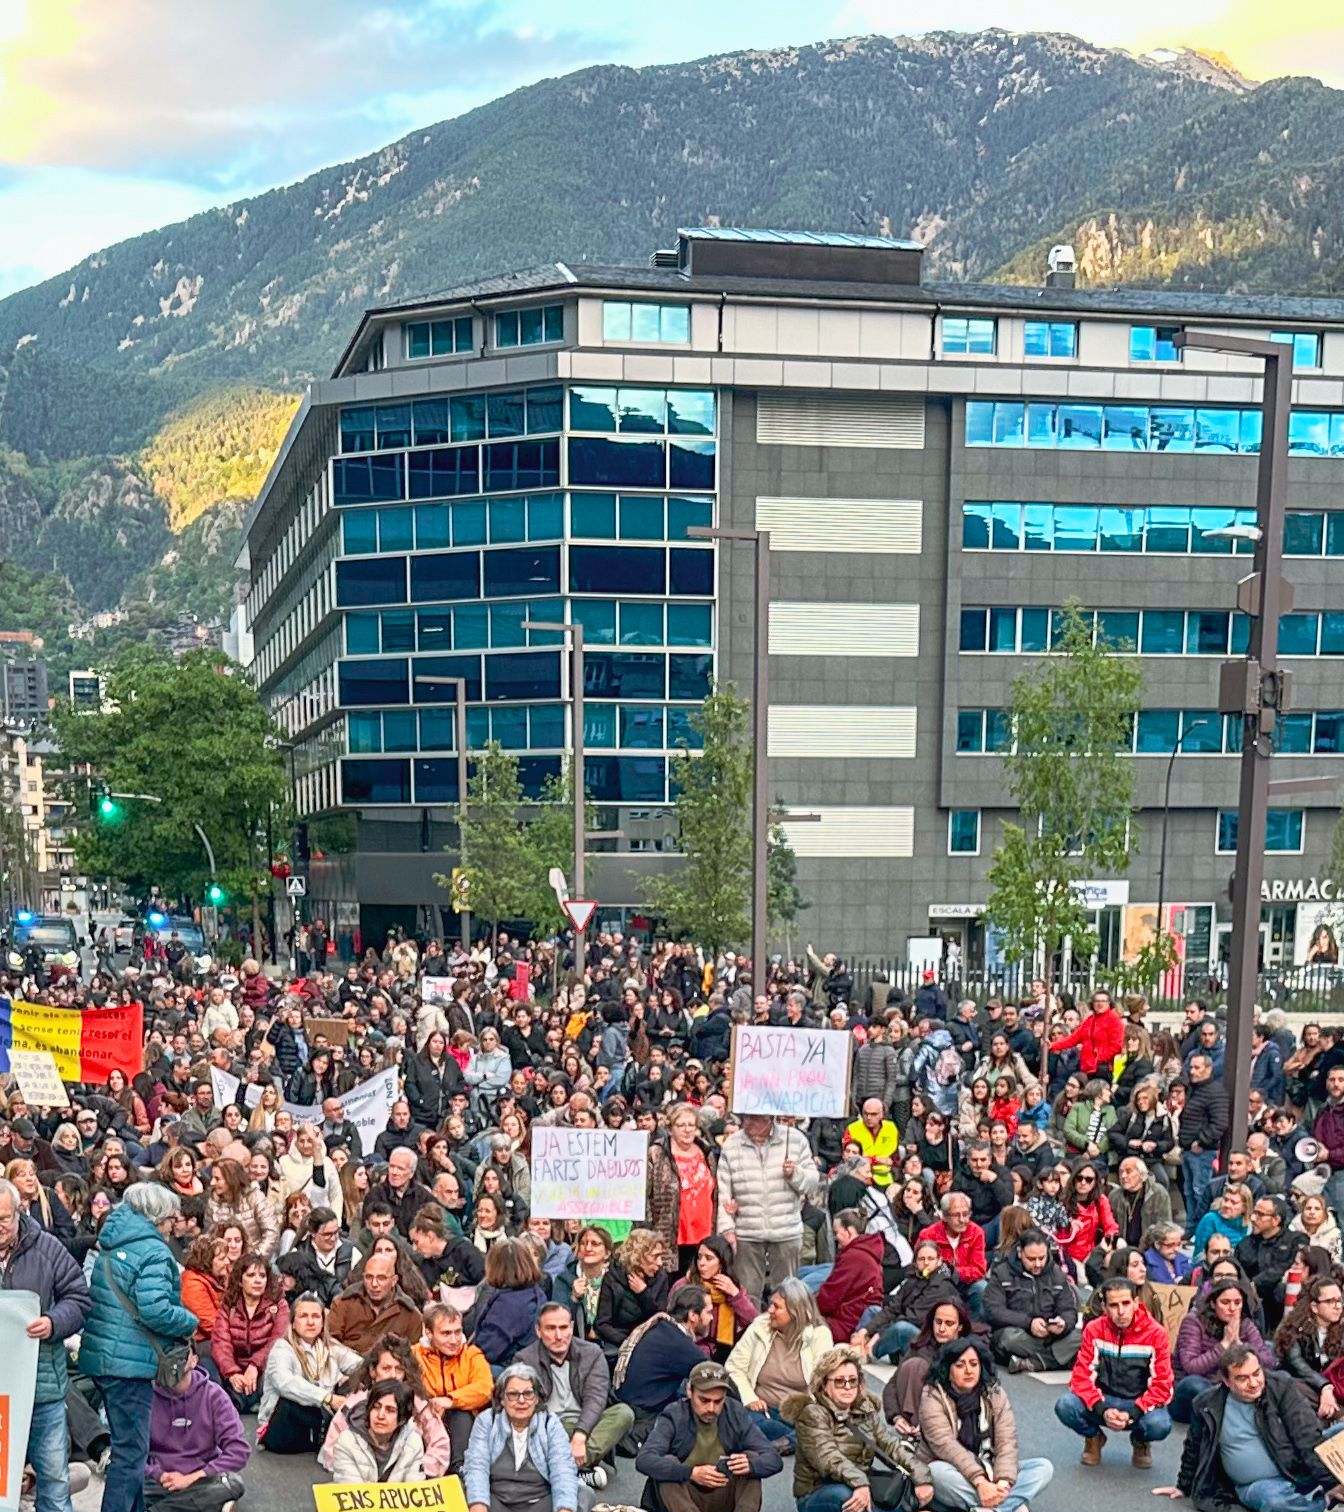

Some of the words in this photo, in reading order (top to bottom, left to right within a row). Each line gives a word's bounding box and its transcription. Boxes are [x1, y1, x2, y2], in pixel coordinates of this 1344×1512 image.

[740, 1032, 796, 1063] BASTA
[801, 1036, 826, 1066] YA
[536, 1132, 562, 1157] JA
[567, 1132, 617, 1157] ESTEM
[534, 1158, 582, 1182] FARTS
[332, 1489, 375, 1512] ENS
[379, 1484, 445, 1509] APUGEN
